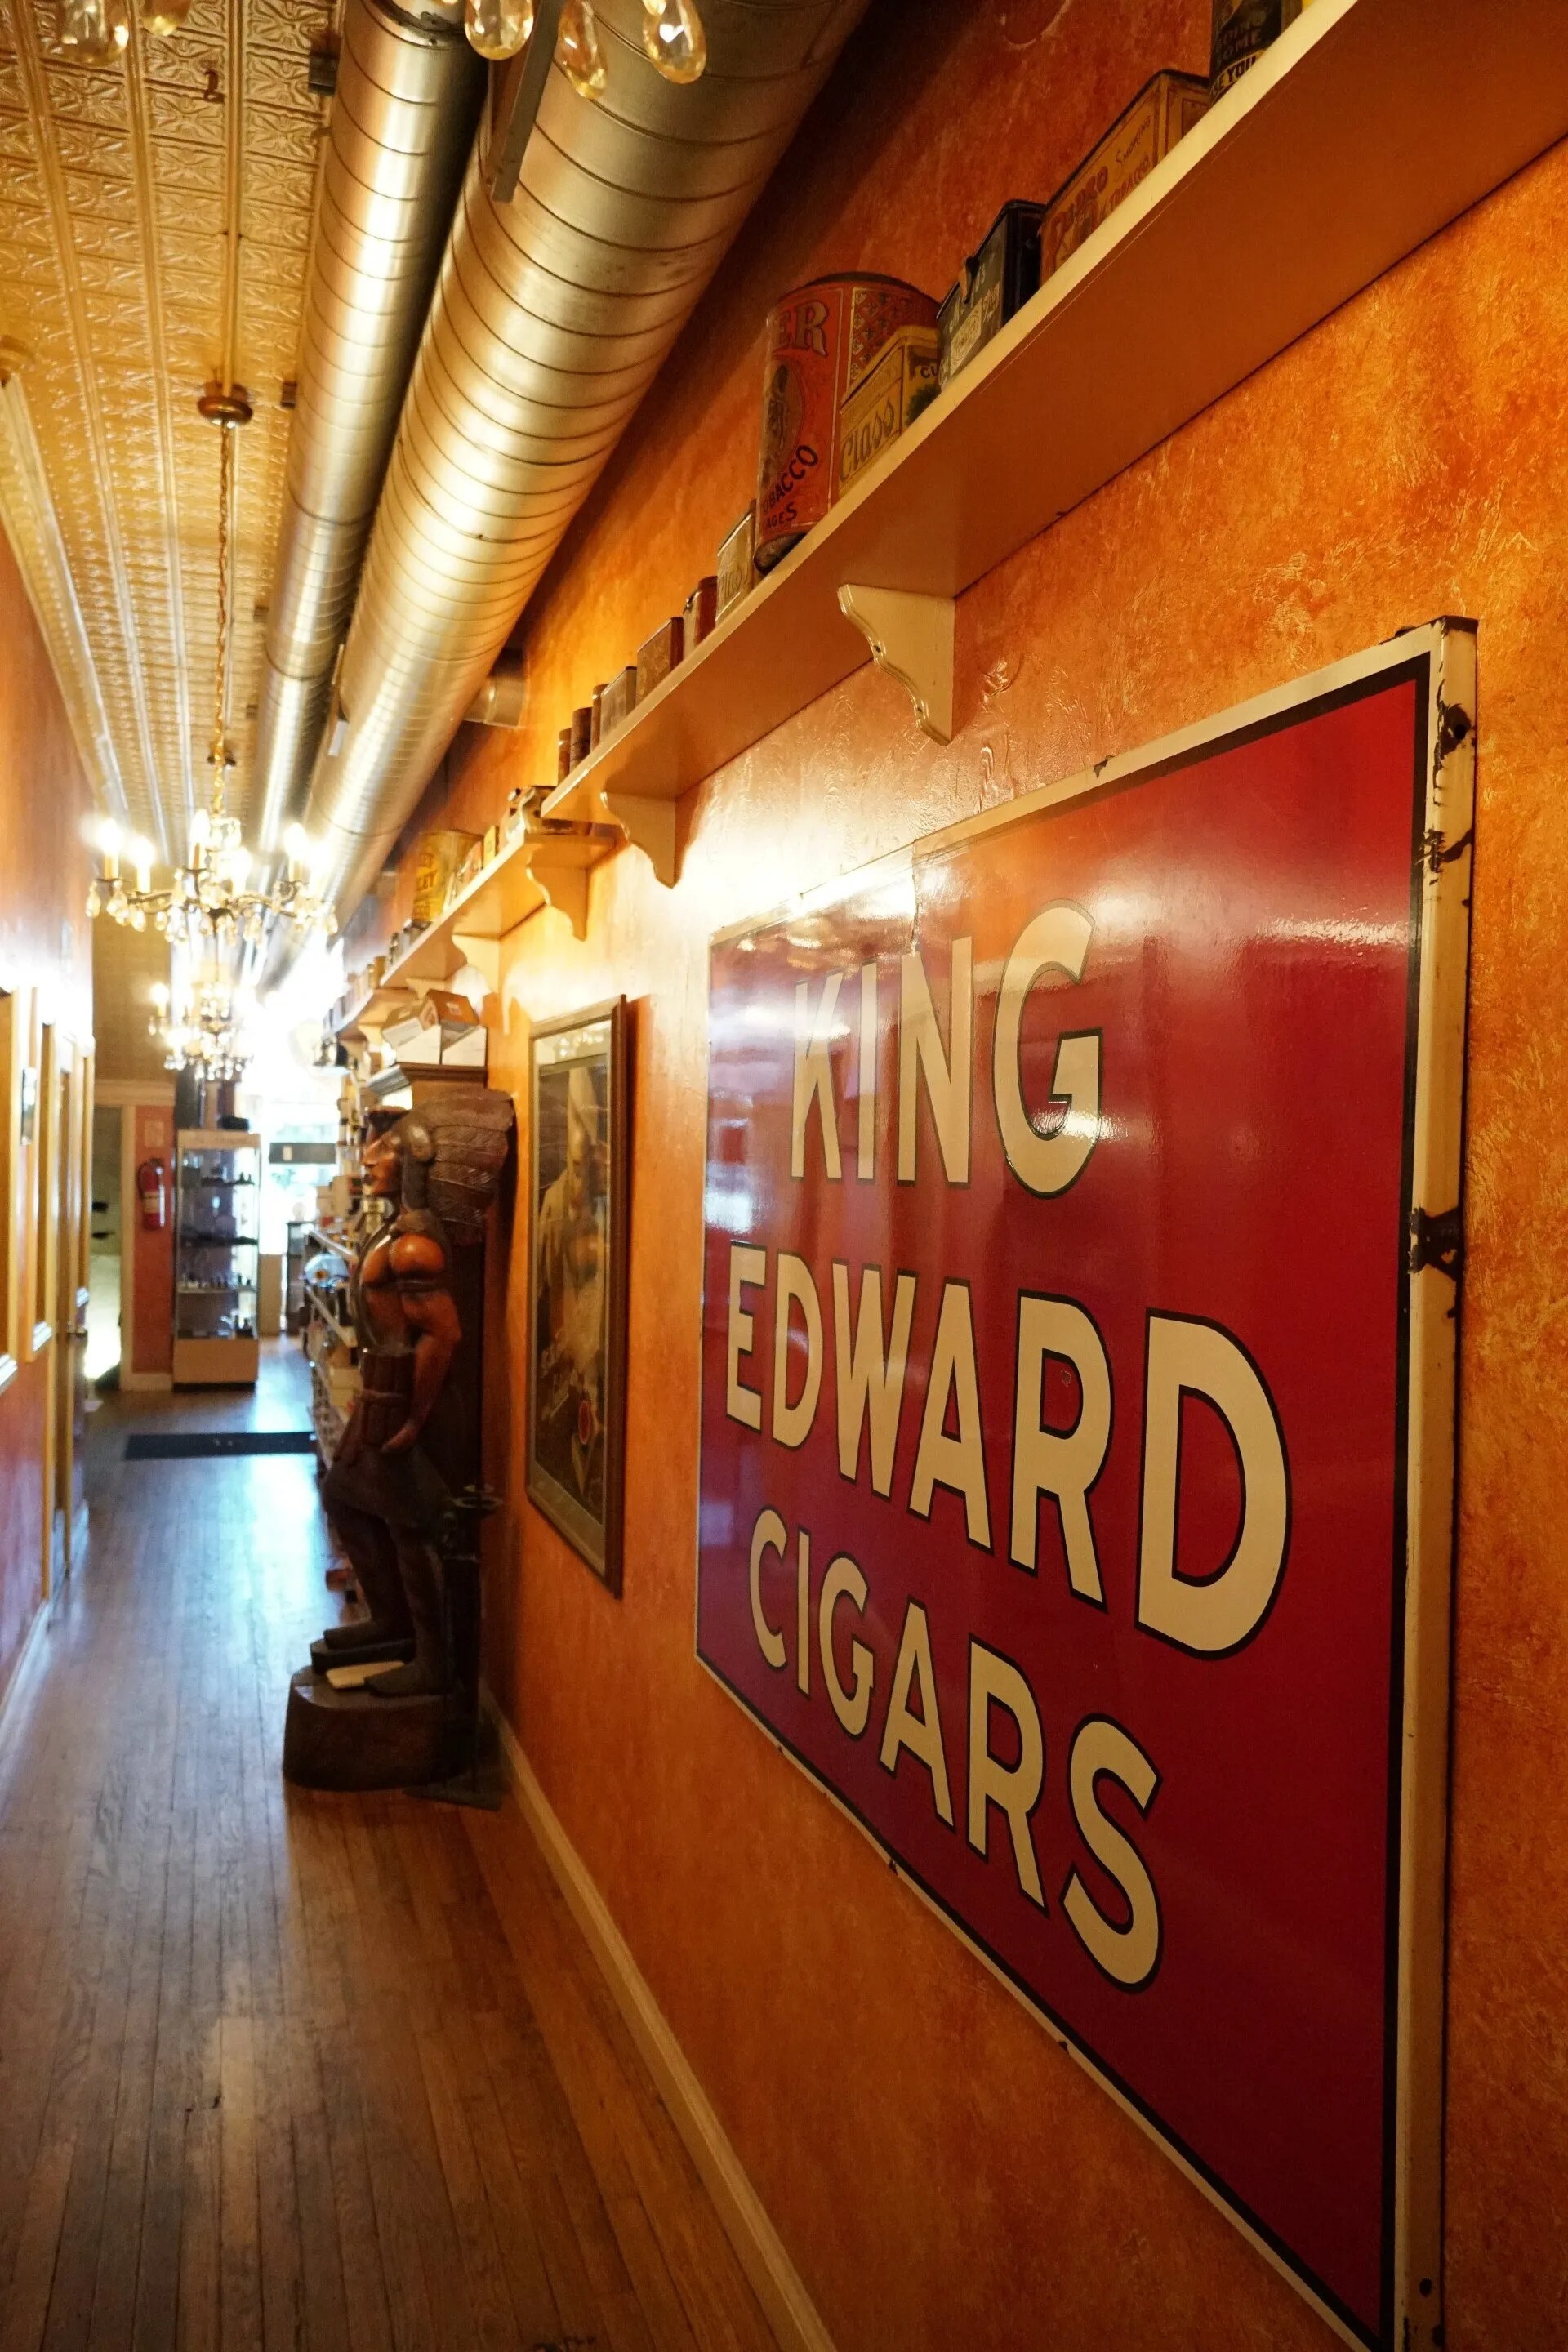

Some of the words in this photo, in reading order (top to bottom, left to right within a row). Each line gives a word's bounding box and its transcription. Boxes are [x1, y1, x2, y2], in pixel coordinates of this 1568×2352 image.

[840, 399, 895, 483] Class
[791, 898, 1104, 1200] KING
[726, 1240, 1292, 1661] EDWARD
[748, 1506, 1164, 1994] CIGARS
